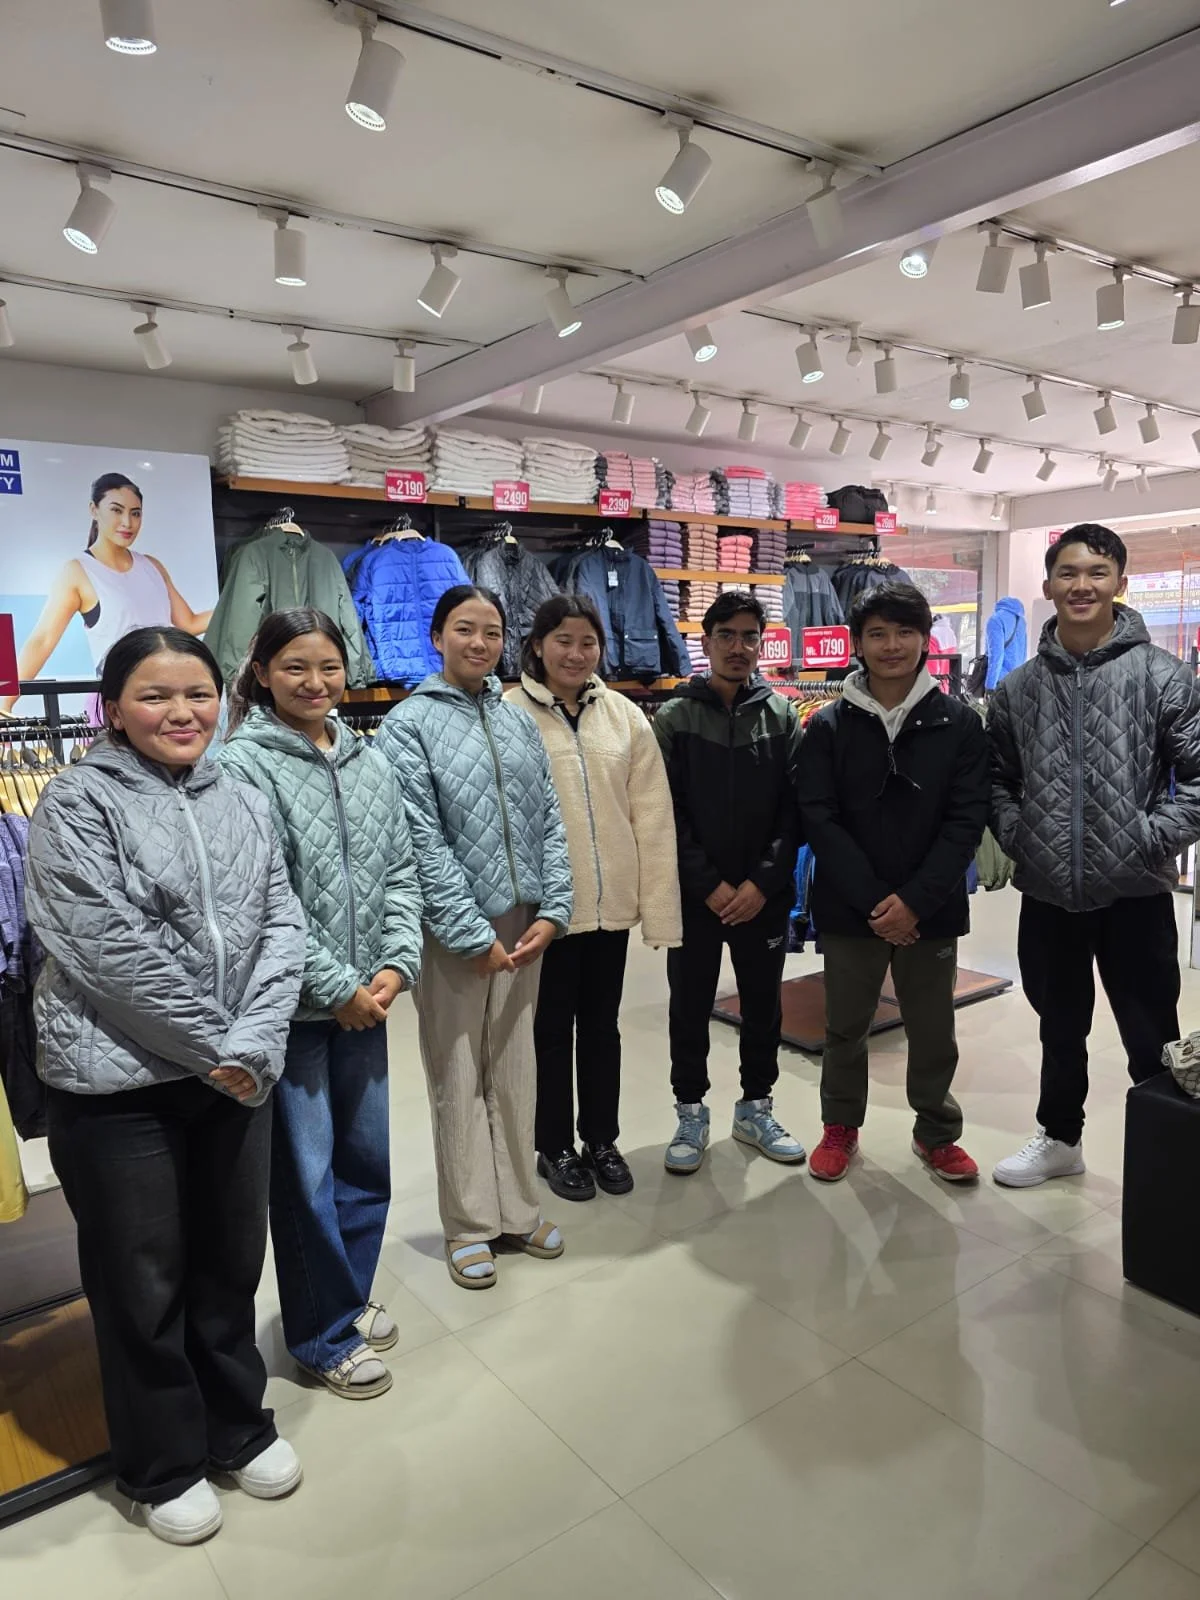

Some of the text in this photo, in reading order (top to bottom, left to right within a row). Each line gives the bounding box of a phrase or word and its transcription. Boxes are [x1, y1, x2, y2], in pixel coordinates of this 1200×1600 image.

[396, 480, 424, 496] 2190
[503, 490, 527, 505] 2490
[608, 497, 629, 511] 2390
[763, 640, 788, 659] 1690
[819, 638, 844, 656] 1790
